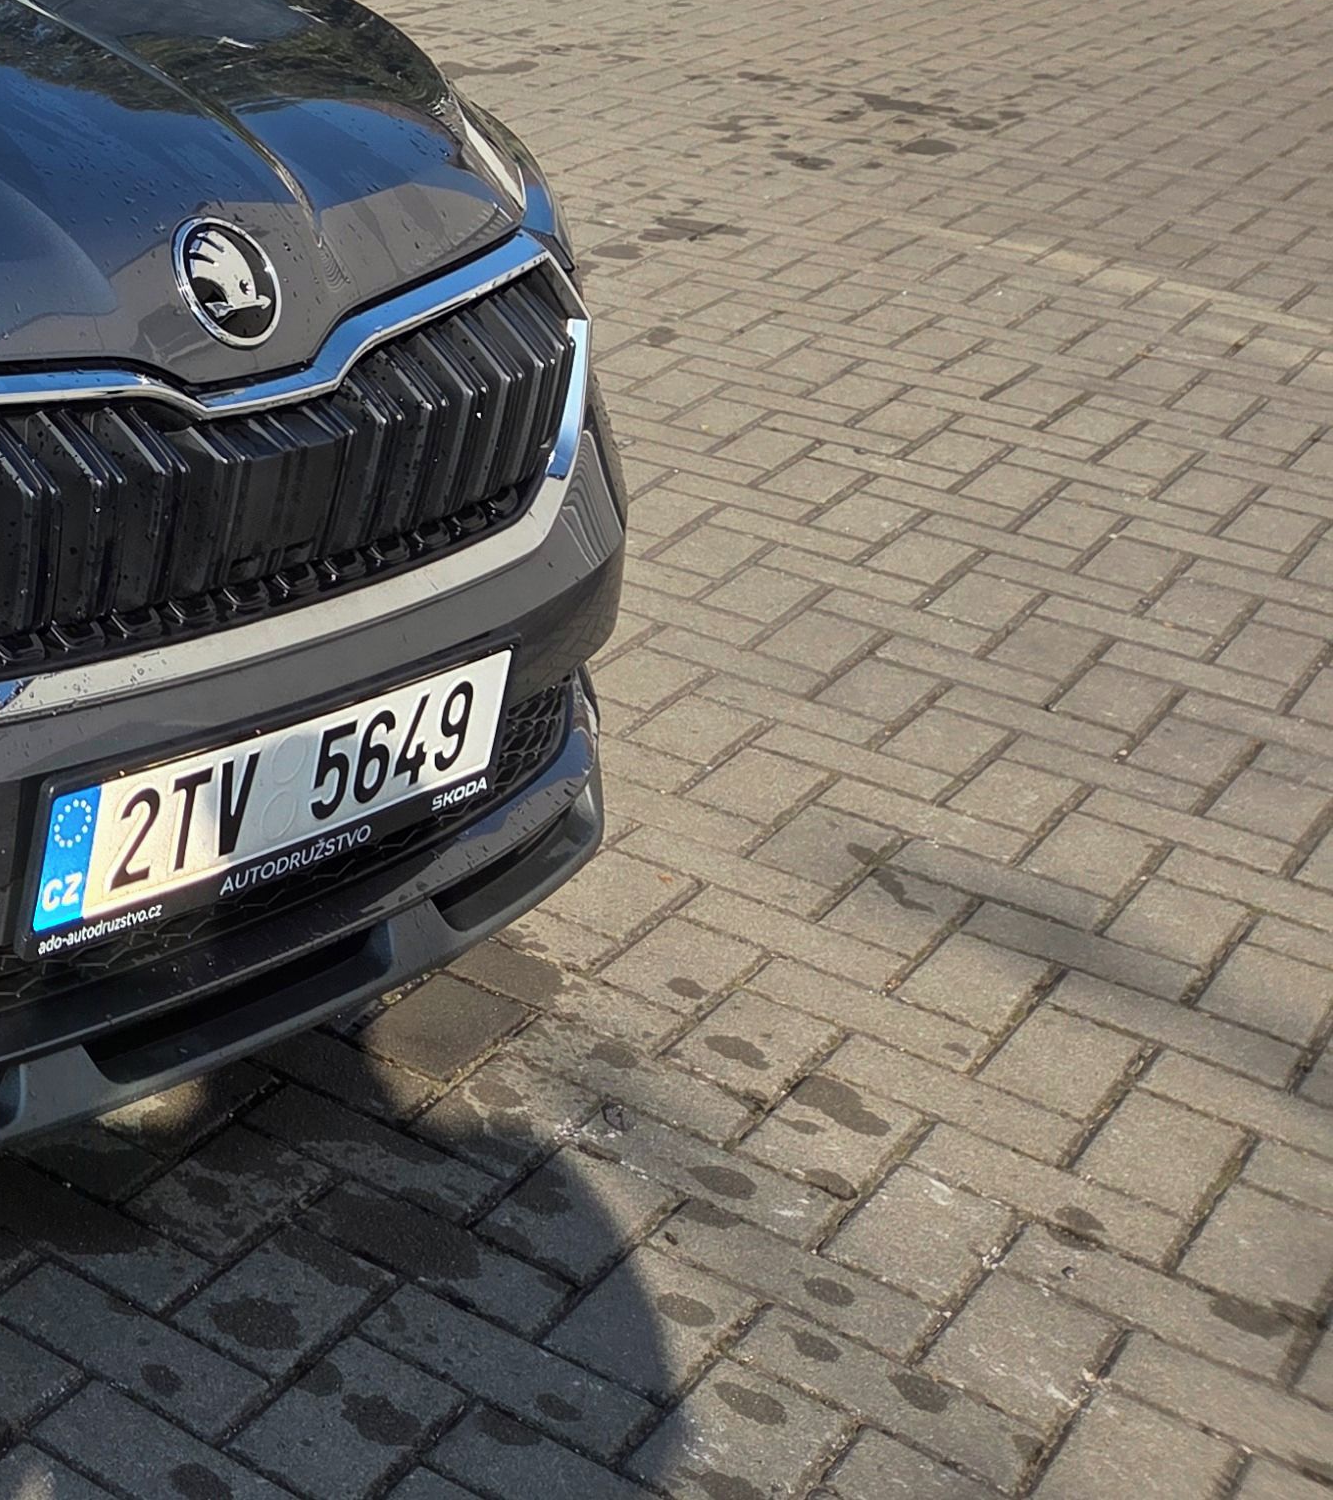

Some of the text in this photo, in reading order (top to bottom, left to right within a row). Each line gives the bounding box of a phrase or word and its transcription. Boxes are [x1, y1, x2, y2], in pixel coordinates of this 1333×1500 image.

[109, 680, 475, 893] 2TV 5649
[219, 824, 372, 897] AUTODRUŽSTVO
[41, 872, 84, 912] CZ
[38, 904, 163, 955] ado-autodruzstvo.cz
